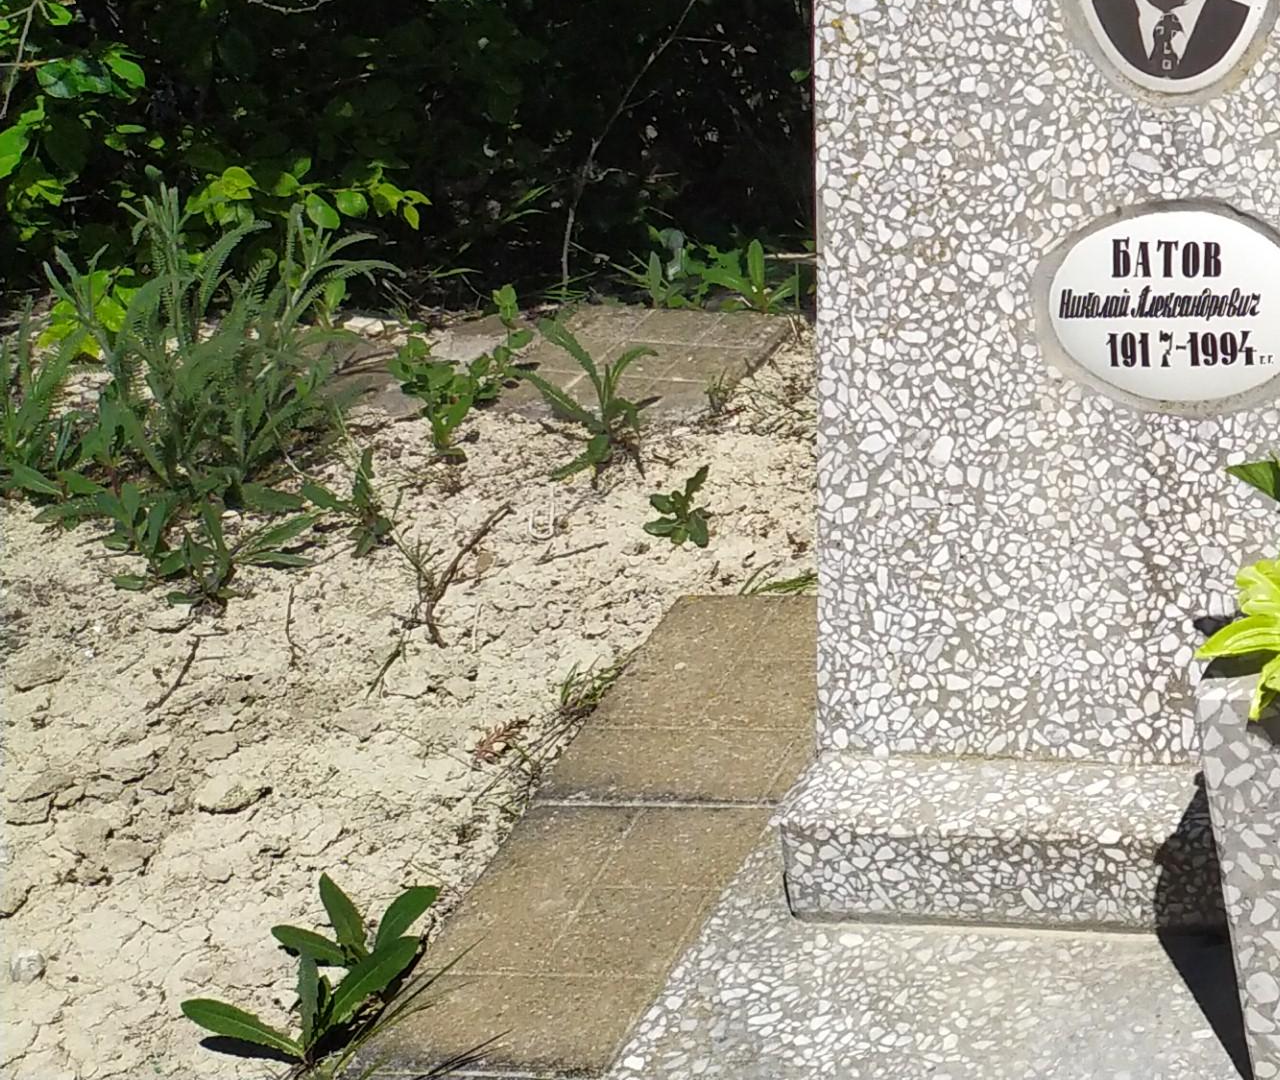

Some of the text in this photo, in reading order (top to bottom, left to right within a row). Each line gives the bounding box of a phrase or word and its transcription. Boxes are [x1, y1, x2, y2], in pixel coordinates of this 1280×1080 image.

[1111, 236, 1222, 278] БАТОВ
[1059, 285, 1261, 321] Николай Александрович
